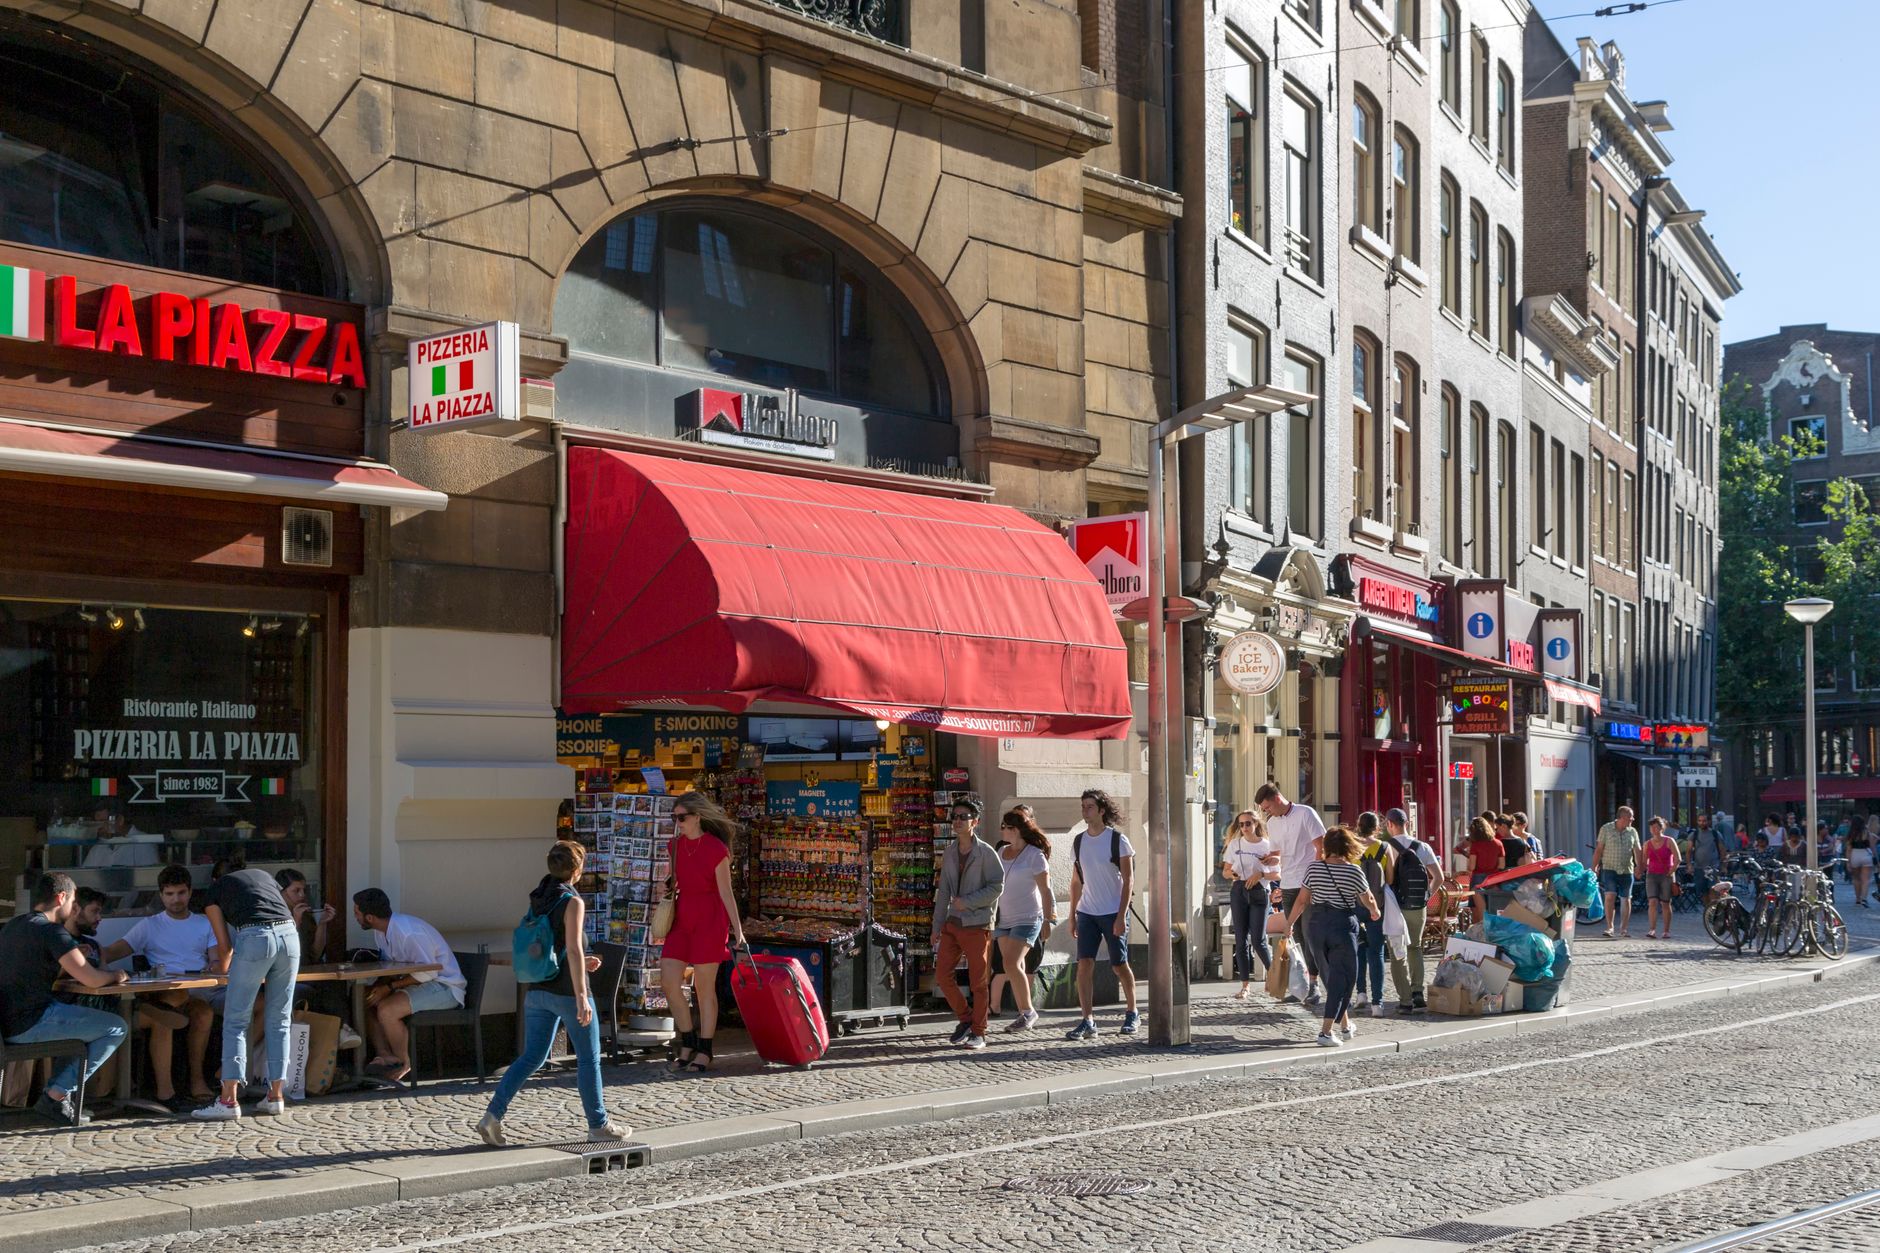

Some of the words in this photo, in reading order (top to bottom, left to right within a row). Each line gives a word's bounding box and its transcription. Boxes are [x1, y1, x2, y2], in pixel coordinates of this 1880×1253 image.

[53, 275, 143, 357] LA
[152, 291, 367, 389] PIAZZA
[416, 329, 490, 365] PIZZERIA
[412, 398, 433, 427] LA
[437, 392, 495, 422] PIAZZA
[742, 386, 839, 446] Marlboro
[1098, 564, 1141, 594] rlboro
[1361, 577, 1416, 615] ARGENTINEAN
[1238, 653, 1262, 664] ICE
[1232, 664, 1269, 675] Bakery
[1453, 684, 1508, 693] RESTAURANT
[123, 698, 198, 718] Ristorante
[201, 700, 256, 719] Italiano
[1453, 698, 1472, 713] LA
[1473, 694, 1508, 711] BOCA
[655, 716, 739, 731] E-SMOKING
[1465, 712, 1498, 721] GRILL
[1455, 722, 1508, 732] PARRILLA
[74, 729, 182, 760] PIZZERIA
[190, 731, 217, 760] LA
[224, 732, 300, 761] PIAZZA
[163, 777, 190, 791] since
[192, 777, 219, 791] 1982
[798, 789, 826, 797] MAGNETS
[290, 1031, 307, 1095] TOPMAN.COM
